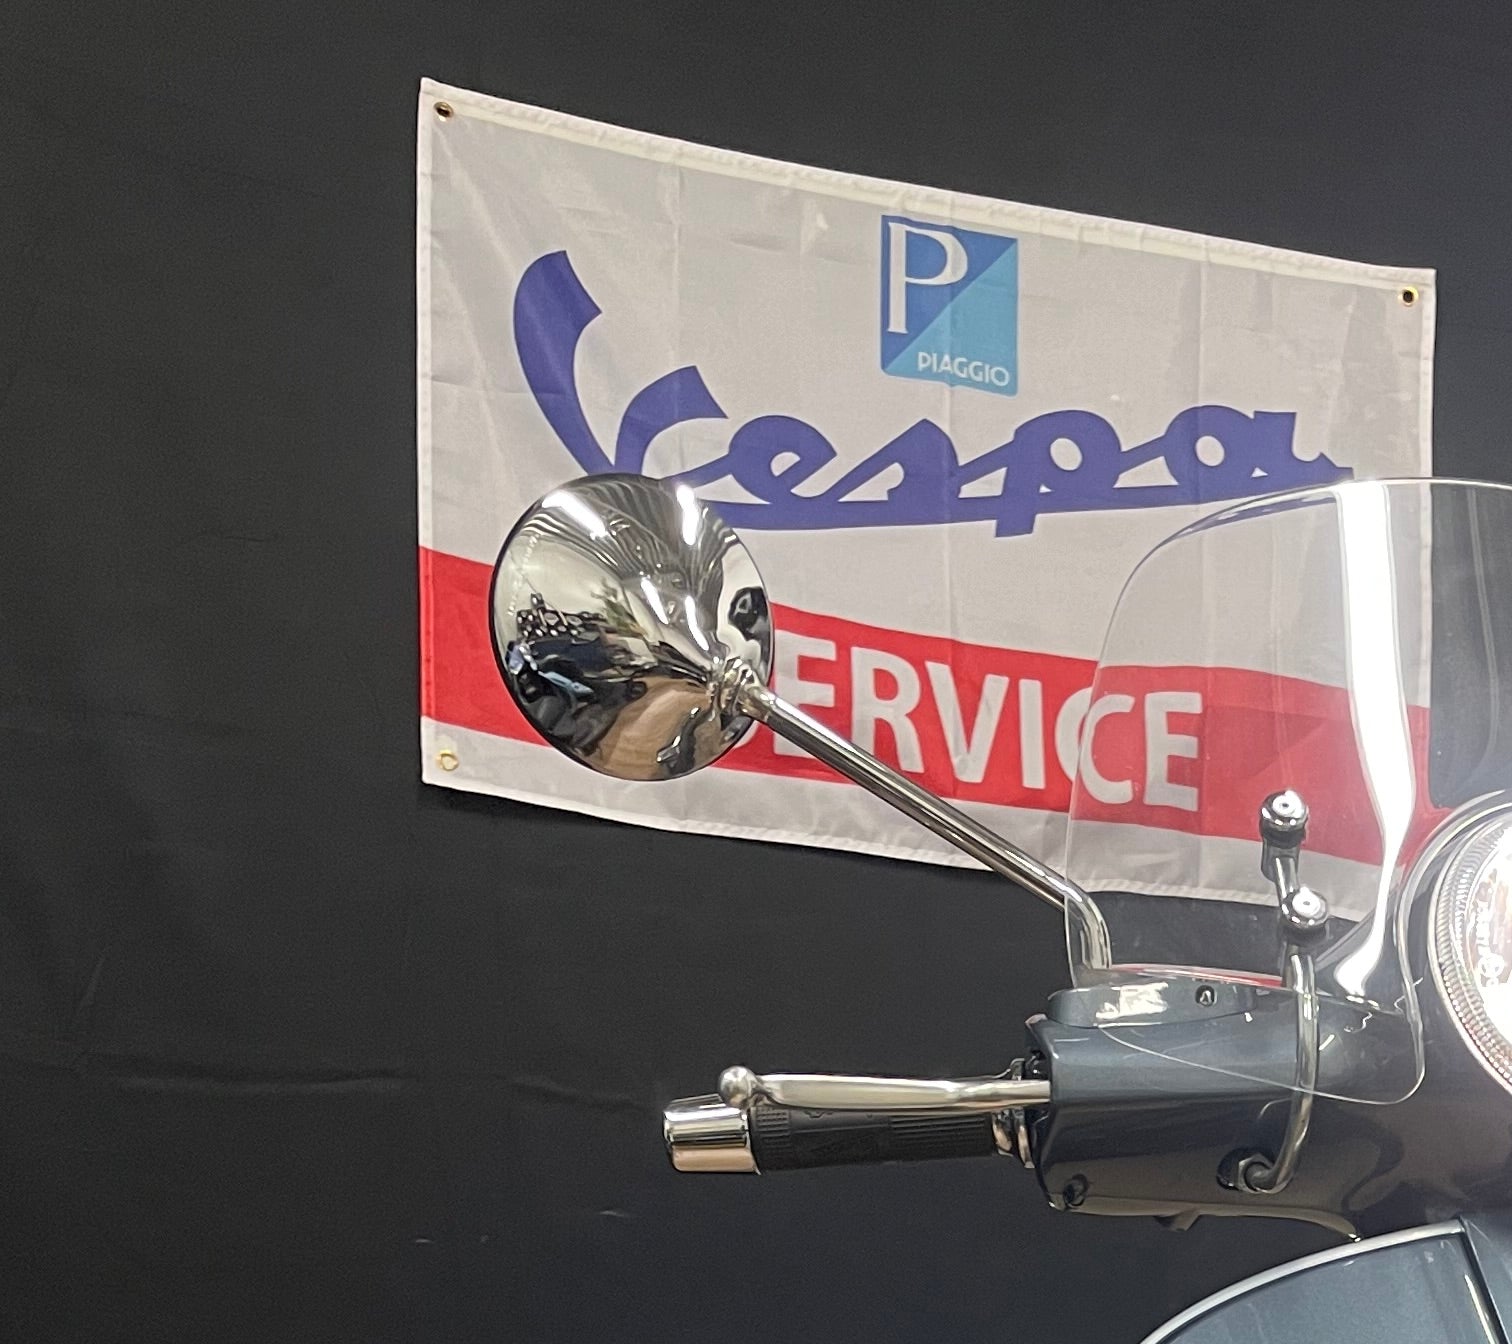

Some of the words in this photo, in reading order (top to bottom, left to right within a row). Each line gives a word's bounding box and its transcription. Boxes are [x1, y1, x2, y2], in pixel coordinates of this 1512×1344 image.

[888, 222, 968, 334] P
[514, 250, 1354, 537] Vespa
[917, 351, 1011, 387] PIAGGIO
[733, 629, 1202, 811] ERVICE
